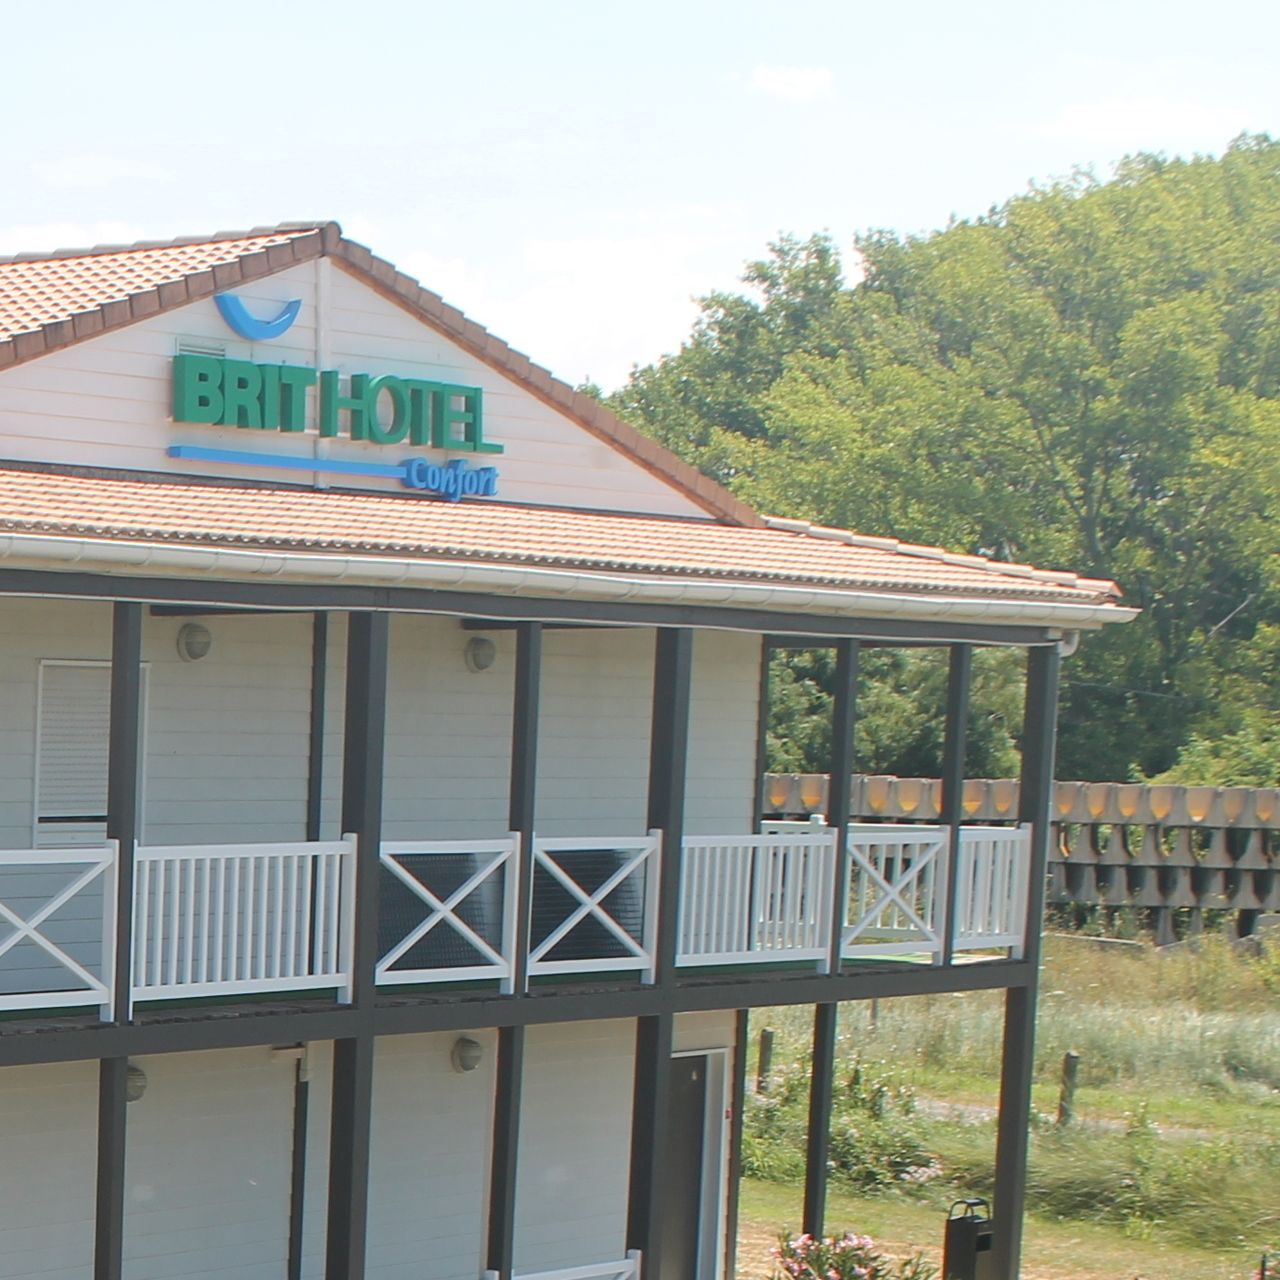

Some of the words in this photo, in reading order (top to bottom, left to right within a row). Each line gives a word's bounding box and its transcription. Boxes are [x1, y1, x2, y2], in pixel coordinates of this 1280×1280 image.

[173, 355, 317, 432] BRIT
[319, 370, 504, 454] HOTEL
[403, 457, 499, 502] Confort
